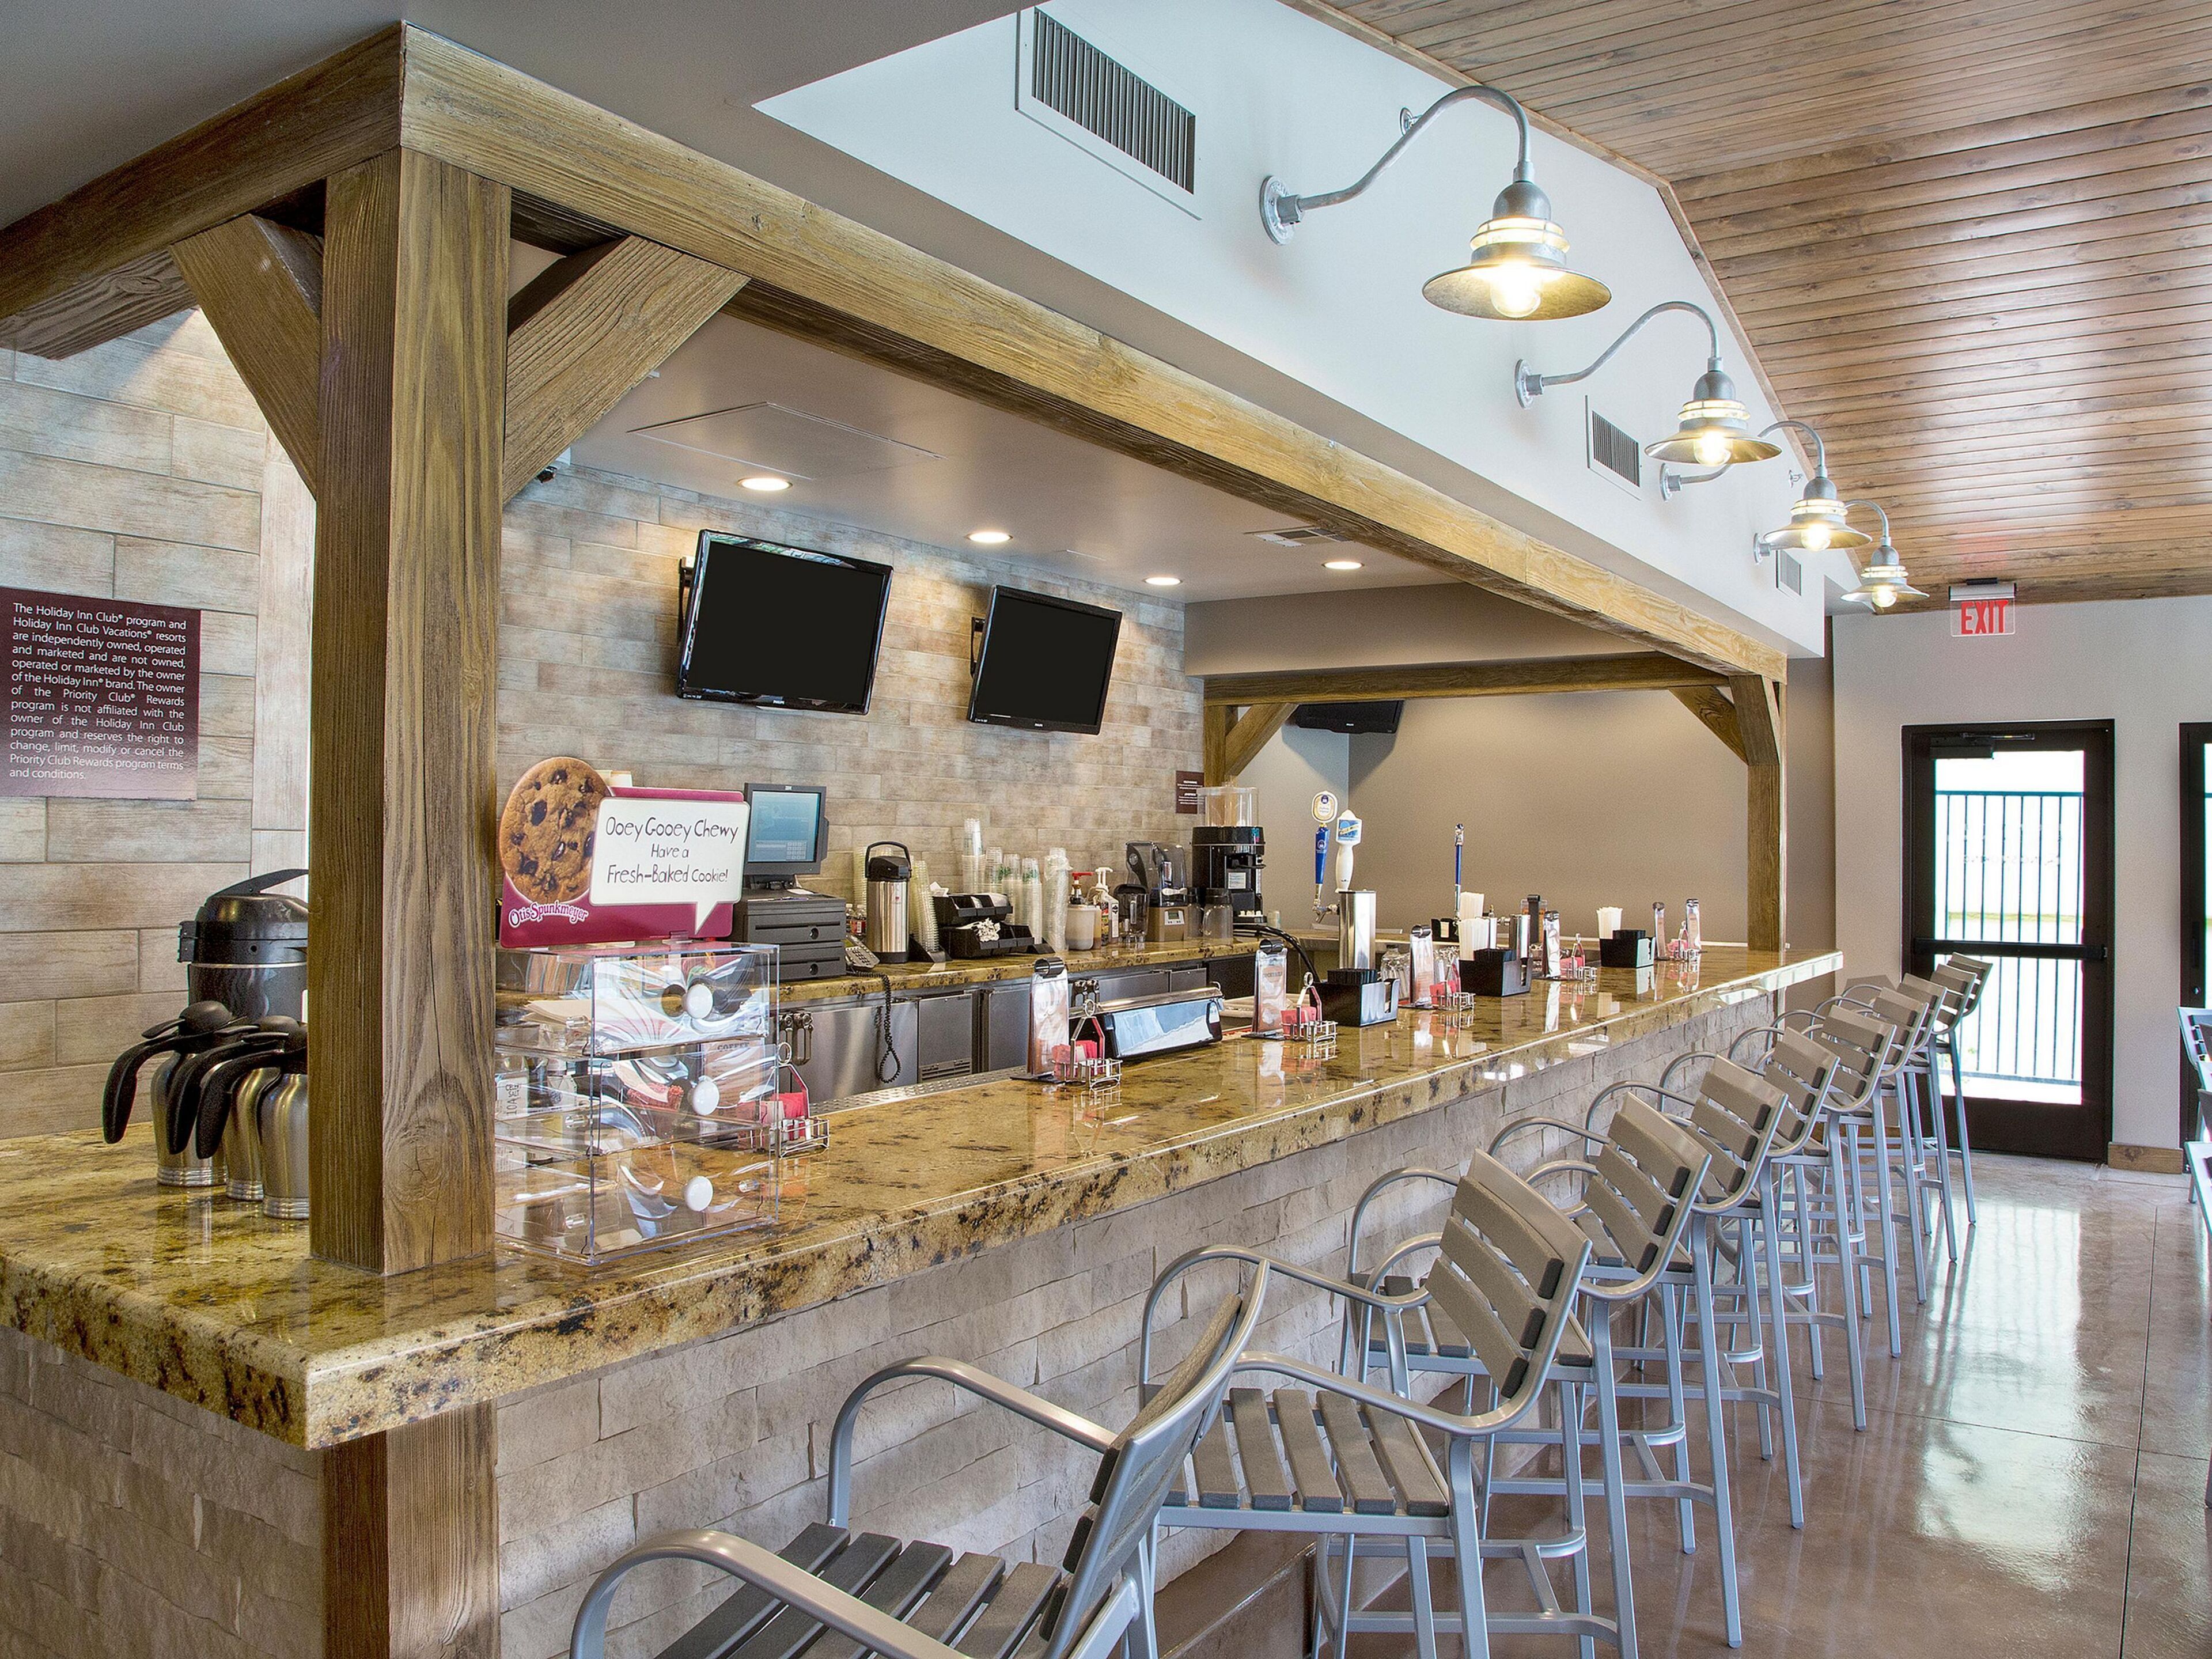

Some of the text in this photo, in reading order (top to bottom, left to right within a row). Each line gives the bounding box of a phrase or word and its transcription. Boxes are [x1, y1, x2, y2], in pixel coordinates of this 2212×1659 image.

[13, 603, 32, 613] The
[37, 606, 74, 619] Holiday
[77, 610, 93, 620] Inn
[127, 616, 165, 628] program
[169, 620, 185, 629] and
[1961, 599, 2009, 634] EXIT
[13, 618, 51, 631] Holiday
[56, 622, 71, 631] Inn
[77, 623, 99, 633] Club
[156, 632, 185, 642] resorts
[32, 633, 104, 649] independently
[108, 641, 142, 652] owned,
[145, 644, 185, 657] operated
[13, 646, 31, 654] and
[38, 647, 84, 659] marketed
[89, 653, 107, 661] and
[132, 656, 147, 664] not
[152, 658, 185, 669] owned,
[12, 661, 185, 680] operated or marketed by the owner
[12, 673, 22, 681] of
[25, 674, 41, 683] the
[44, 675, 81, 687] Holiday
[106, 680, 135, 690] brand.
[137, 682, 154, 691] The
[156, 685, 184, 693] owner
[12, 686, 22, 695] of
[35, 688, 51, 696] the
[64, 690, 97, 702] Priority
[147, 696, 184, 706] Rewards
[12, 701, 184, 719] program is not affiliated with the
[11, 715, 184, 732] owner of the Holiday Inn Club
[11, 729, 183, 745] program and reserves the right to
[10, 742, 50, 752] change,
[55, 743, 78, 753] limit,
[84, 744, 116, 756] modify
[135, 747, 164, 756] cancel
[169, 748, 183, 757] the
[10, 754, 183, 770] Priority Club Rewards program terms
[10, 768, 85, 779] and conditions.
[606, 817, 738, 843] Ooey Gooey Chewy
[651, 843, 689, 858] Have a
[607, 865, 728, 884] Fresh-Baked Cookie!
